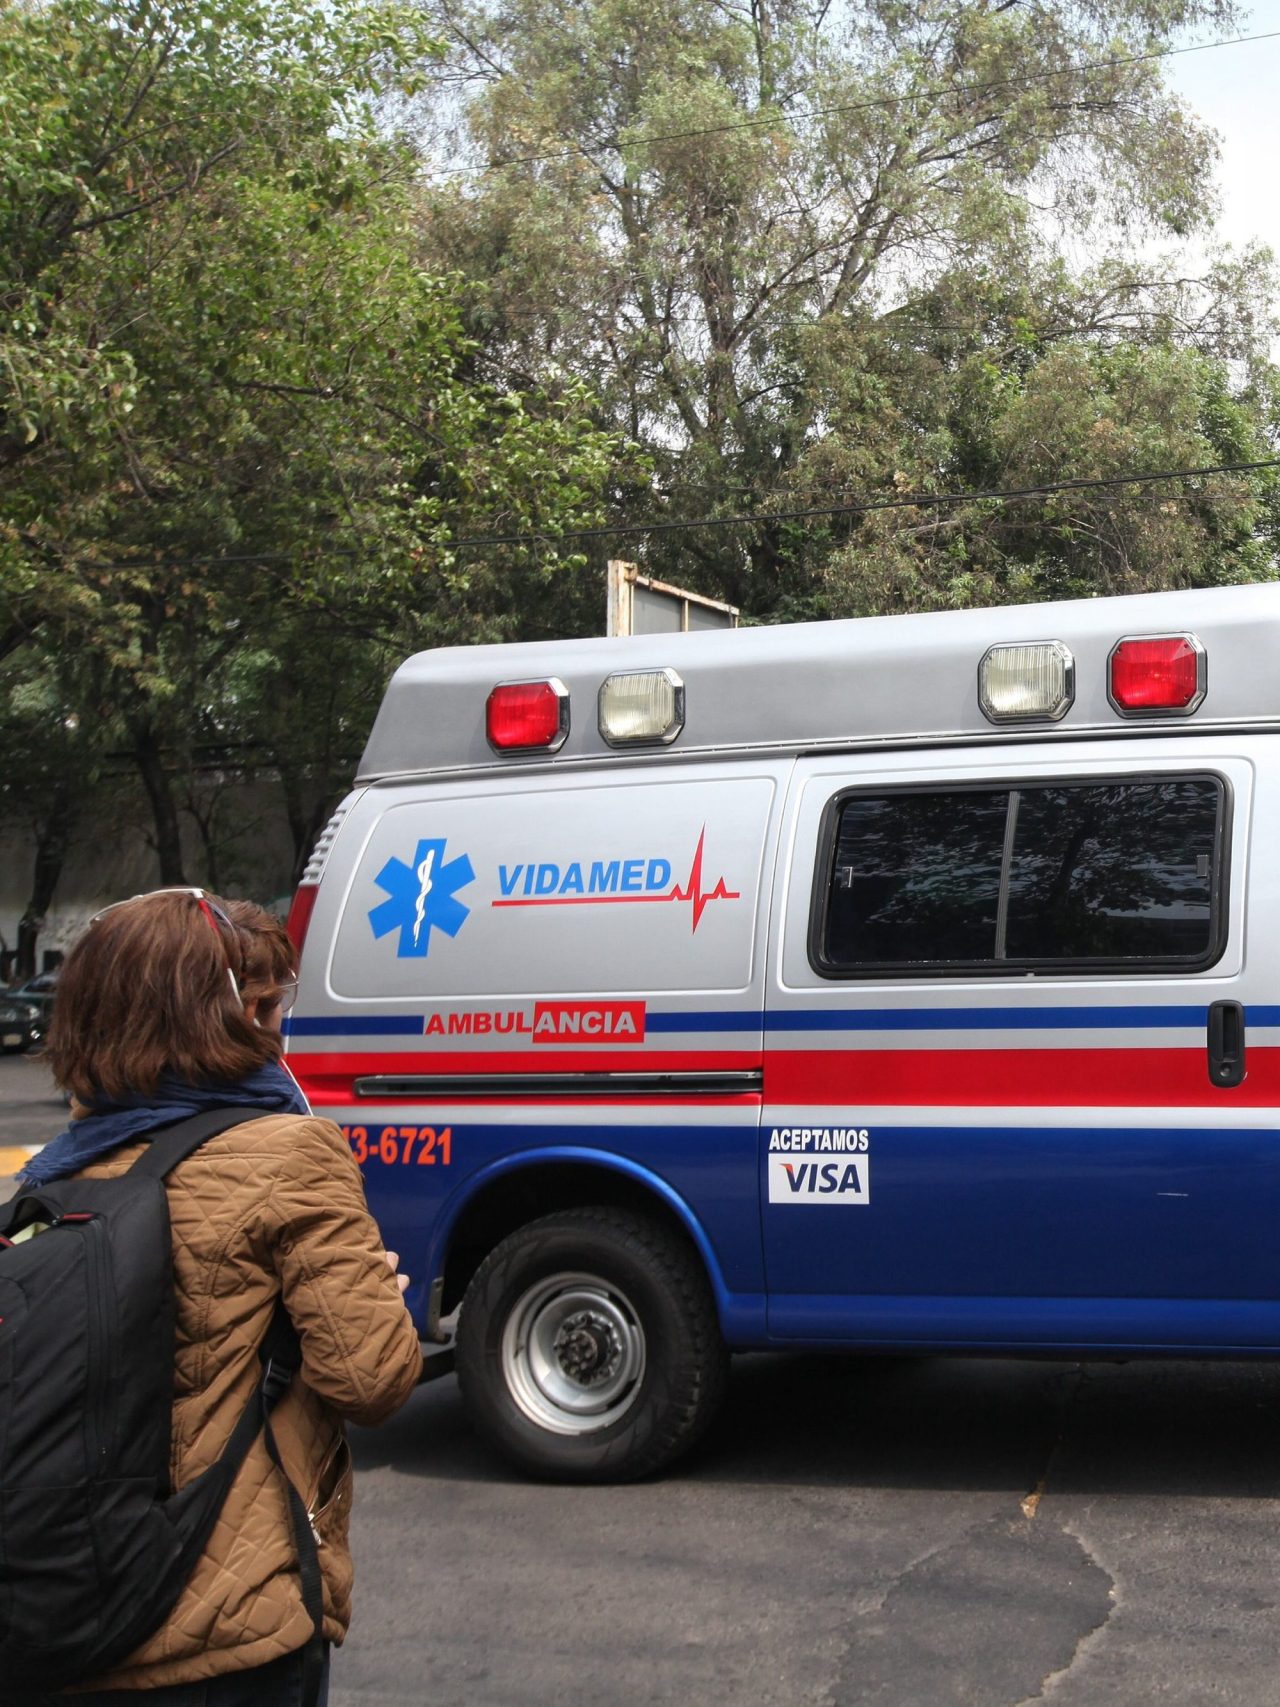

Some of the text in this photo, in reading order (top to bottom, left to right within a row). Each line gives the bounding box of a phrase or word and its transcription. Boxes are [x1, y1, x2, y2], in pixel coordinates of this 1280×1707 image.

[498, 859, 671, 895] VIDAMED
[424, 1010, 637, 1036] AMBULANCIA
[769, 1129, 869, 1151] ACEPTAMOS
[779, 1163, 862, 1193] VISA
